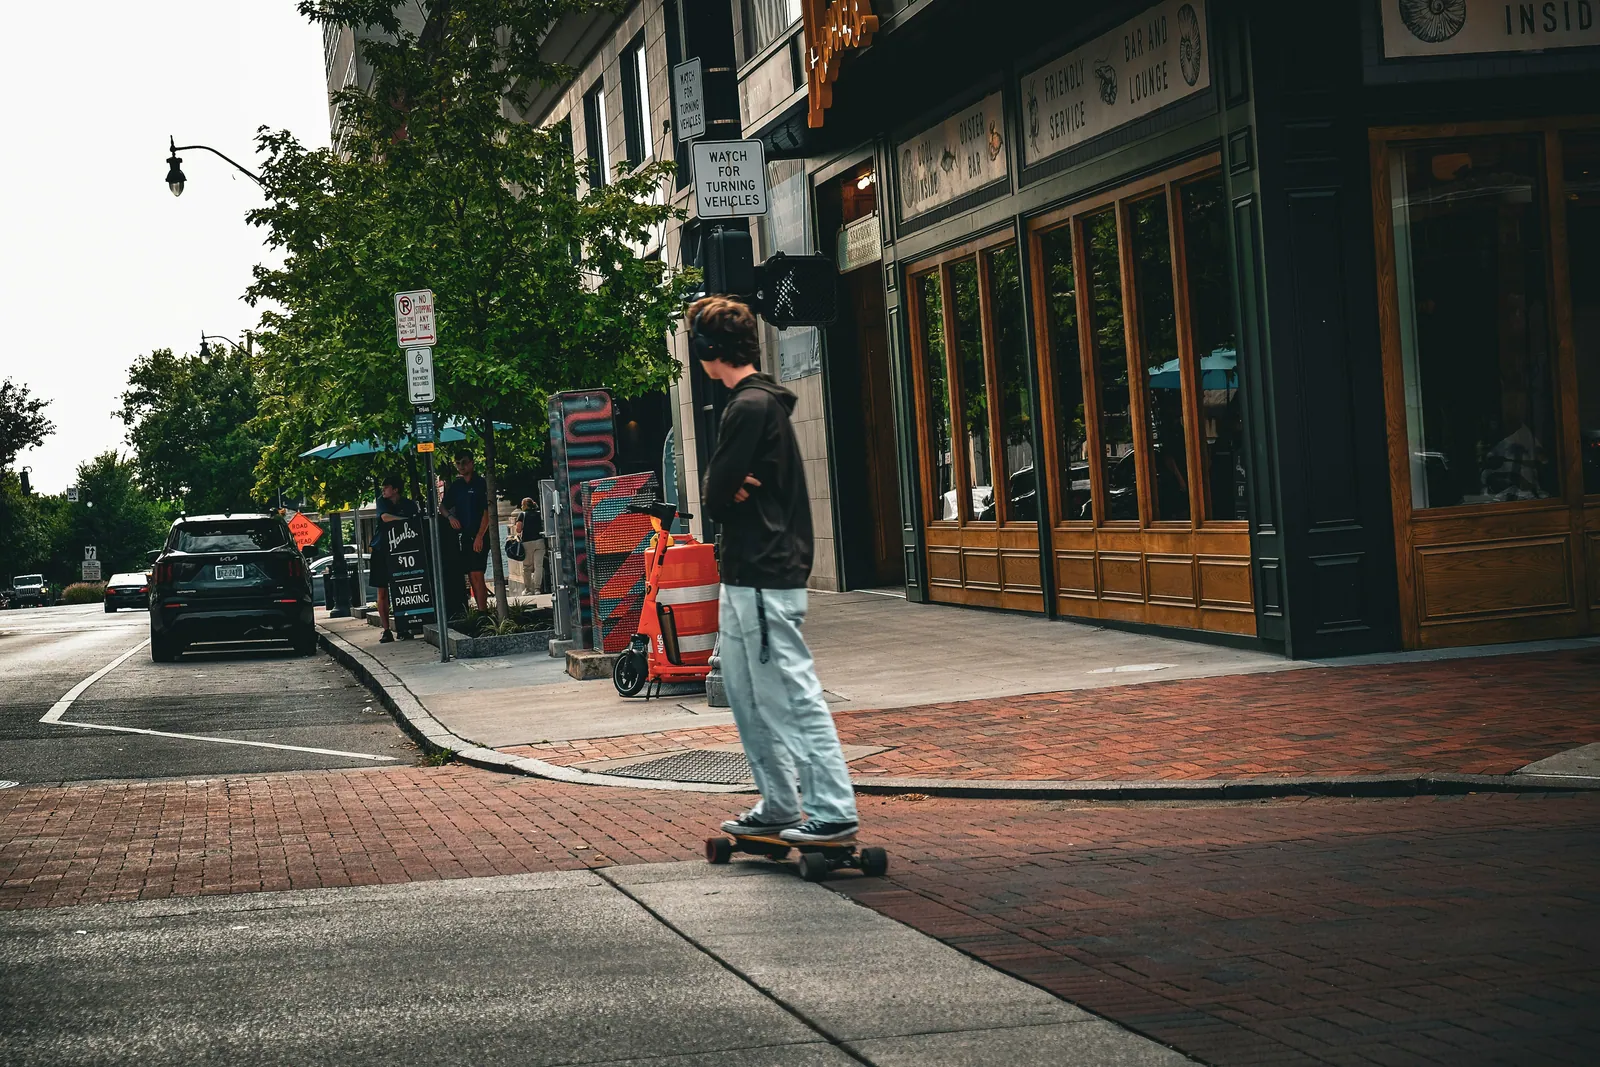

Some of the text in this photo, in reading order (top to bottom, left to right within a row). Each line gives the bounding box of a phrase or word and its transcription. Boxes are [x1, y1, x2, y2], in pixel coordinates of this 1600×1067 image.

[1505, 1, 1600, 35] INSID
[1124, 15, 1168, 63] BAR AND
[680, 70, 696, 85] WATCH
[1045, 58, 1085, 103] FRIENDLY
[1129, 60, 1169, 104] LOUNGE
[683, 87, 693, 98] FOR
[680, 99, 699, 115] TURNING
[680, 115, 701, 130] VEHICLES
[1049, 100, 1086, 141] SERVICE
[959, 111, 985, 145] OYSTER
[709, 150, 747, 163] WATCH
[718, 166, 740, 177] FOR
[968, 151, 982, 179] BAR
[706, 180, 755, 192] TURNING
[704, 194, 759, 207] VEHICLES
[418, 295, 427, 304] NO
[415, 304, 432, 314] STOPPING
[419, 323, 431, 331] TIME
[398, 555, 416, 568] $10
[398, 583, 423, 595] VALET
[395, 593, 430, 606] PARKING
[656, 634, 664, 654] SPIN
